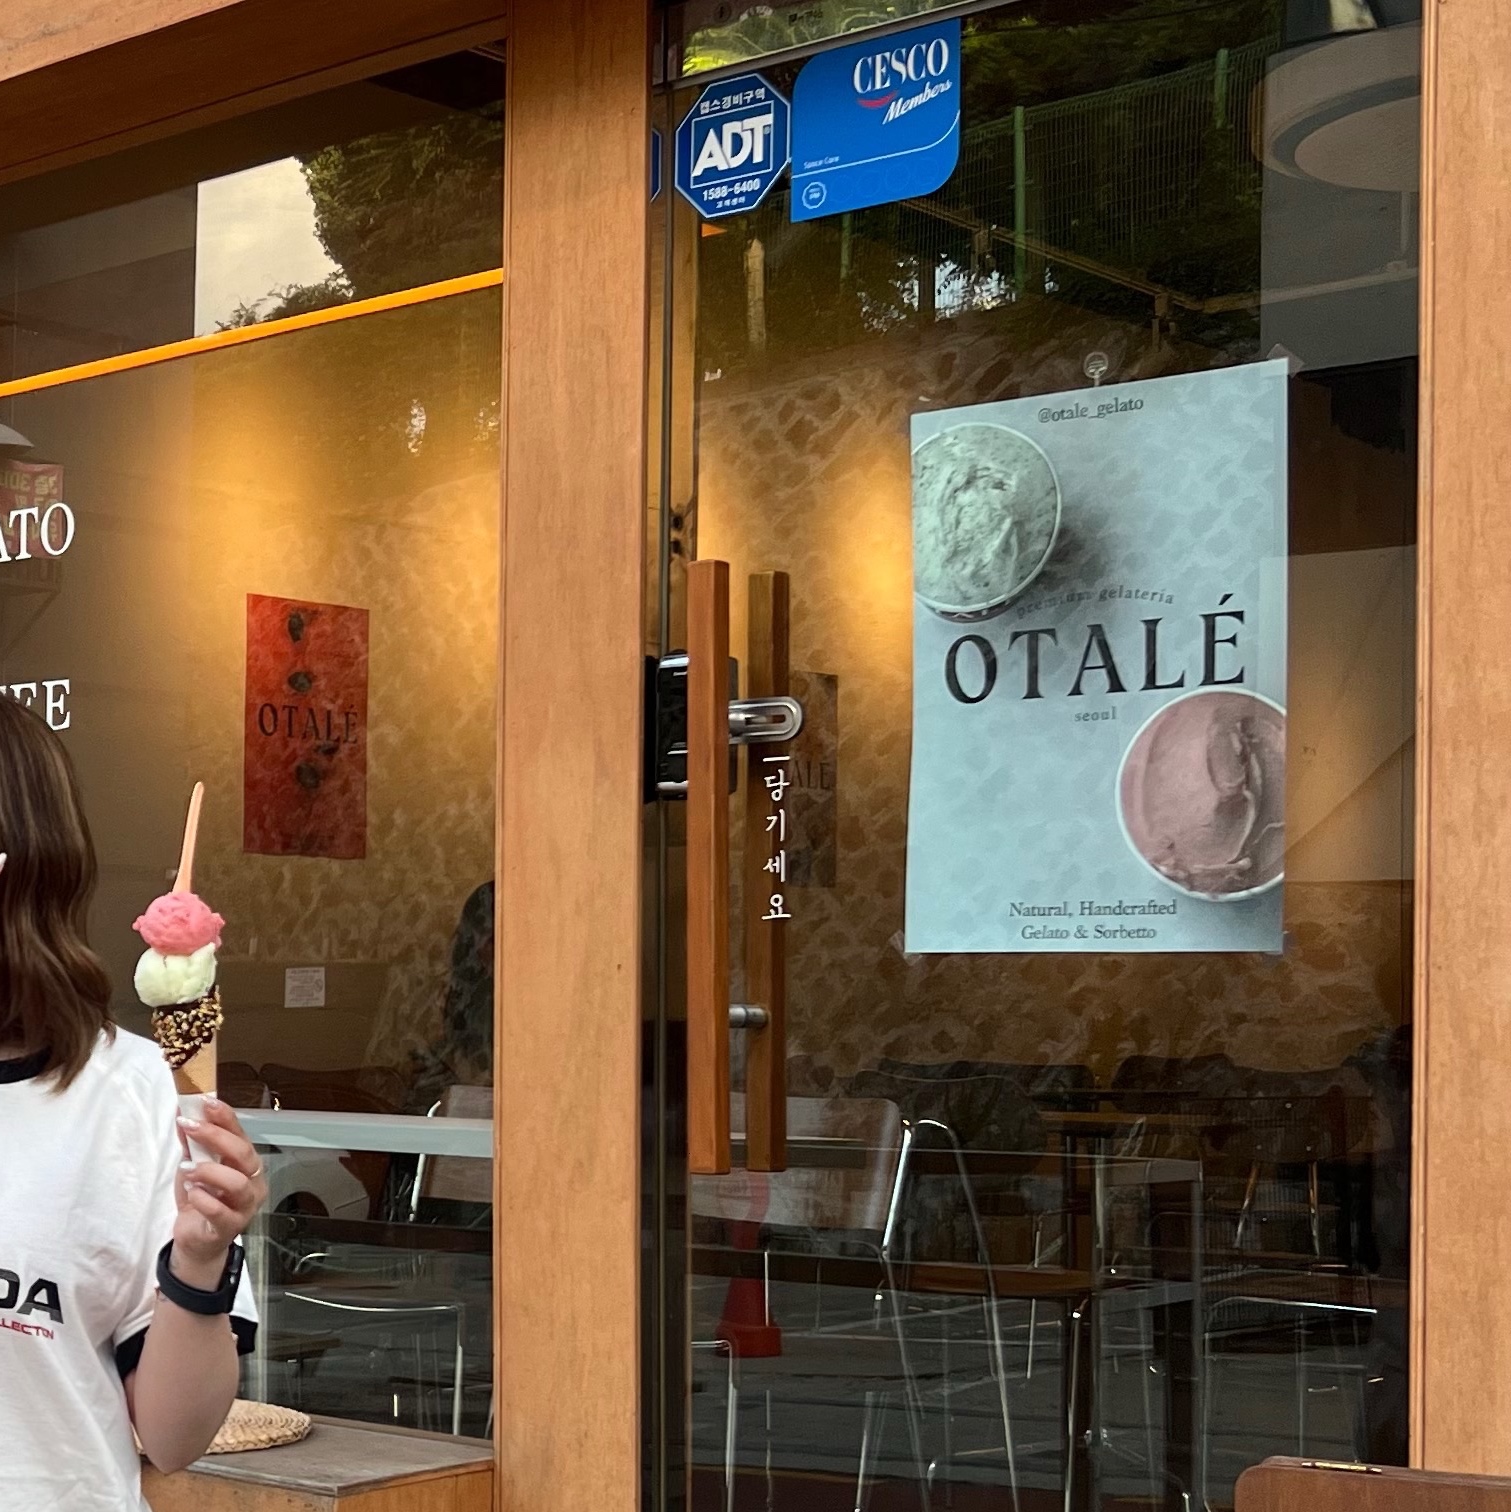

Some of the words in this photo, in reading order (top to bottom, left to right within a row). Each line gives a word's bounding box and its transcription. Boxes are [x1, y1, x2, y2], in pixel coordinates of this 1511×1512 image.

[853, 38, 949, 94] CESCO
[882, 79, 952, 125] Members
[692, 113, 773, 177] ADT
[702, 178, 761, 201] 1588-6400
[1038, 396, 1144, 424] @otale_gelato
[1099, 585, 1175, 604] gelateria
[945, 593, 1245, 704] OTALÉ
[1074, 706, 1117, 722] seoul
[761, 769, 791, 920] 당기세요
[1009, 901, 1073, 918] Natural,
[1079, 899, 1177, 916] Handcrafted
[1021, 924, 1070, 939] Gelato
[1074, 925, 1089, 939] &
[1093, 924, 1157, 939] Sorbetto
